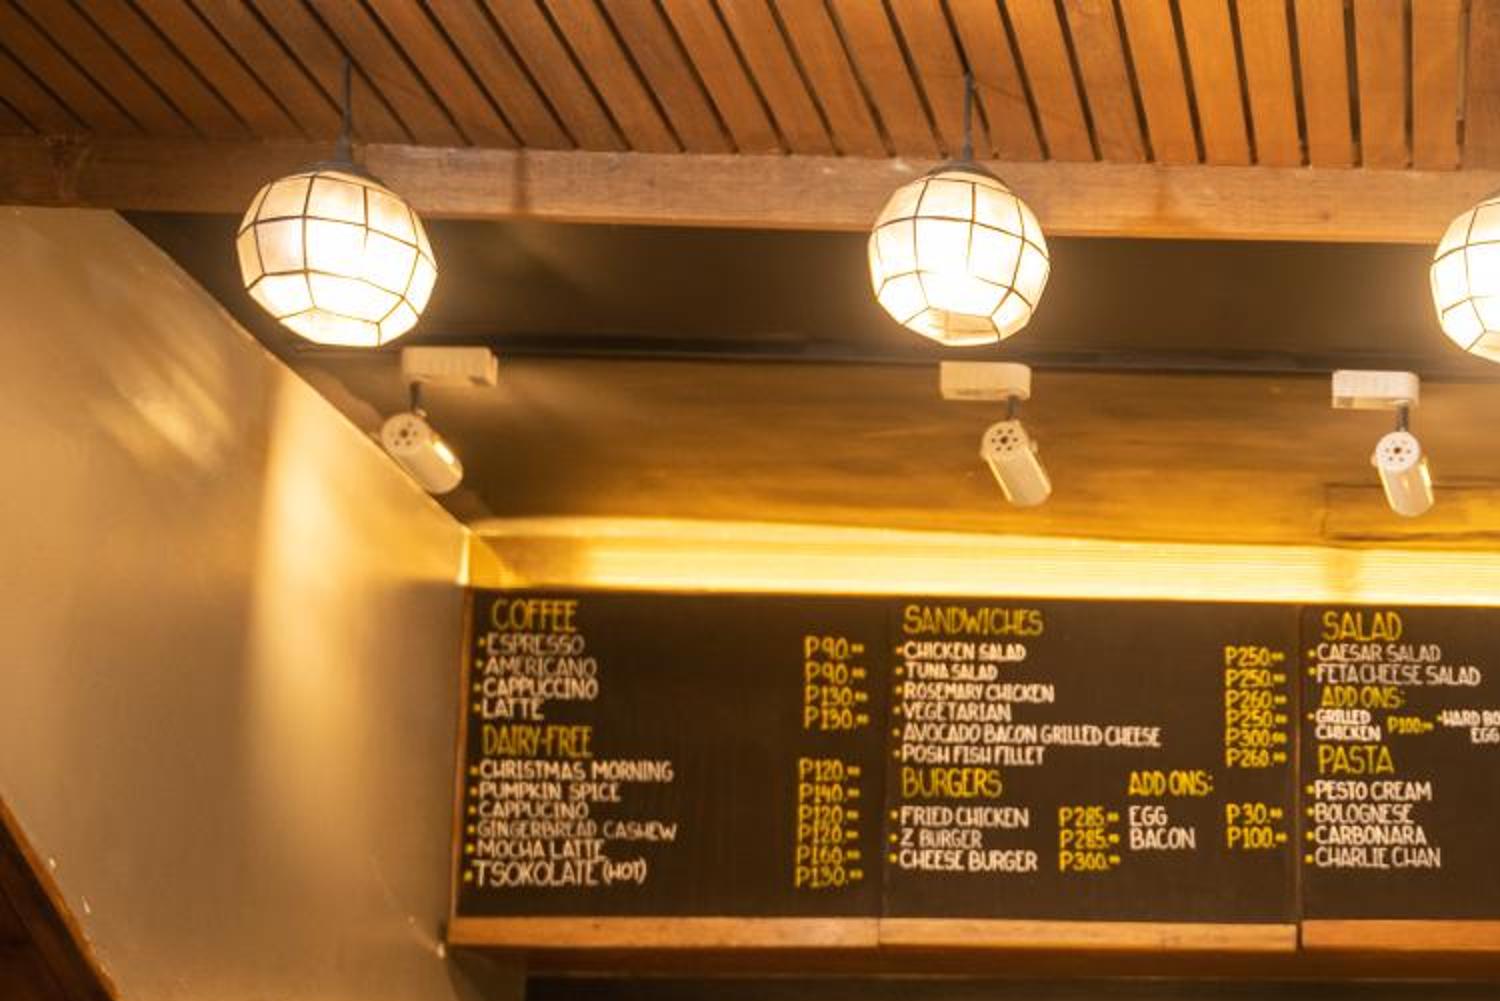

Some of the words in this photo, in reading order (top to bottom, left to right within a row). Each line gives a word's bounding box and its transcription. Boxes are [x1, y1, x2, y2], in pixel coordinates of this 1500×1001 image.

[492, 599, 577, 632] COFFEE
[903, 605, 1043, 634] SANDWICHES
[1322, 611, 1402, 642] SALAD
[487, 633, 584, 655] ESPRESSO
[903, 641, 975, 660] CHICKEN
[979, 643, 1026, 661] SALAD
[1317, 643, 1382, 662] CAESAR
[1386, 644, 1440, 662] SALAD
[485, 656, 597, 678] AMERICANO
[906, 662, 949, 678] TUNA
[951, 663, 998, 681] SALAD
[1316, 664, 1358, 684] FETA
[1360, 664, 1423, 685] CHEESE
[1426, 666, 1481, 686] SALAD
[482, 678, 598, 700] CAPPUCCINO
[902, 682, 983, 700] ROSEMARY
[986, 684, 1054, 702] CHICKEN
[1322, 686, 1358, 706] ADD
[1360, 686, 1405, 708] ONS:
[482, 698, 544, 720] LATTE
[902, 704, 1012, 722] VEGETARIAN
[1315, 710, 1371, 725] GRILLED
[1443, 710, 1480, 727] HARD
[483, 725, 592, 757] DAIRY-FREE
[902, 724, 981, 743] AVOCADO
[984, 724, 1037, 744] BACON
[1041, 725, 1102, 746] GRILLED
[1105, 727, 1161, 748] CHEESE
[1315, 725, 1381, 742] CHICKEN
[1472, 728, 1500, 744] EGG
[902, 746, 950, 763] POSH
[954, 746, 992, 764] FISH
[995, 746, 1046, 766] FILLET
[1318, 745, 1394, 774] PASTA
[480, 759, 585, 780] CHRISTMAS
[592, 760, 674, 782] MORNING
[479, 781, 561, 800] PUMPKIN
[570, 782, 621, 802] SPICE
[902, 767, 1002, 798] BURGERS
[1128, 771, 1166, 795] ADD
[1170, 771, 1214, 796] ONS:
[1314, 780, 1368, 800] PESTO
[1370, 781, 1432, 801] CREAM
[479, 802, 588, 819] CAPPUCINO
[901, 805, 952, 826] FRIED
[956, 807, 1029, 828] CHICKEN
[1128, 806, 1168, 826] EGG
[1314, 802, 1414, 824] BOLOGNESE
[478, 820, 596, 840] GINGERBREAD
[604, 821, 677, 841] CASHEW
[901, 828, 914, 847] Z
[919, 829, 982, 848] BURGER
[1129, 828, 1196, 850] BACON
[1315, 825, 1427, 845] CARBONARA
[477, 840, 545, 859] MOCHA
[551, 838, 606, 862] LATTE
[900, 849, 964, 871] CHEESE
[968, 850, 1038, 872] BURGER
[1315, 846, 1390, 868] CHARLIE
[1392, 848, 1441, 868] CHAN
[472, 860, 600, 887] TSOKOLATE
[602, 858, 646, 885] (HOT)
